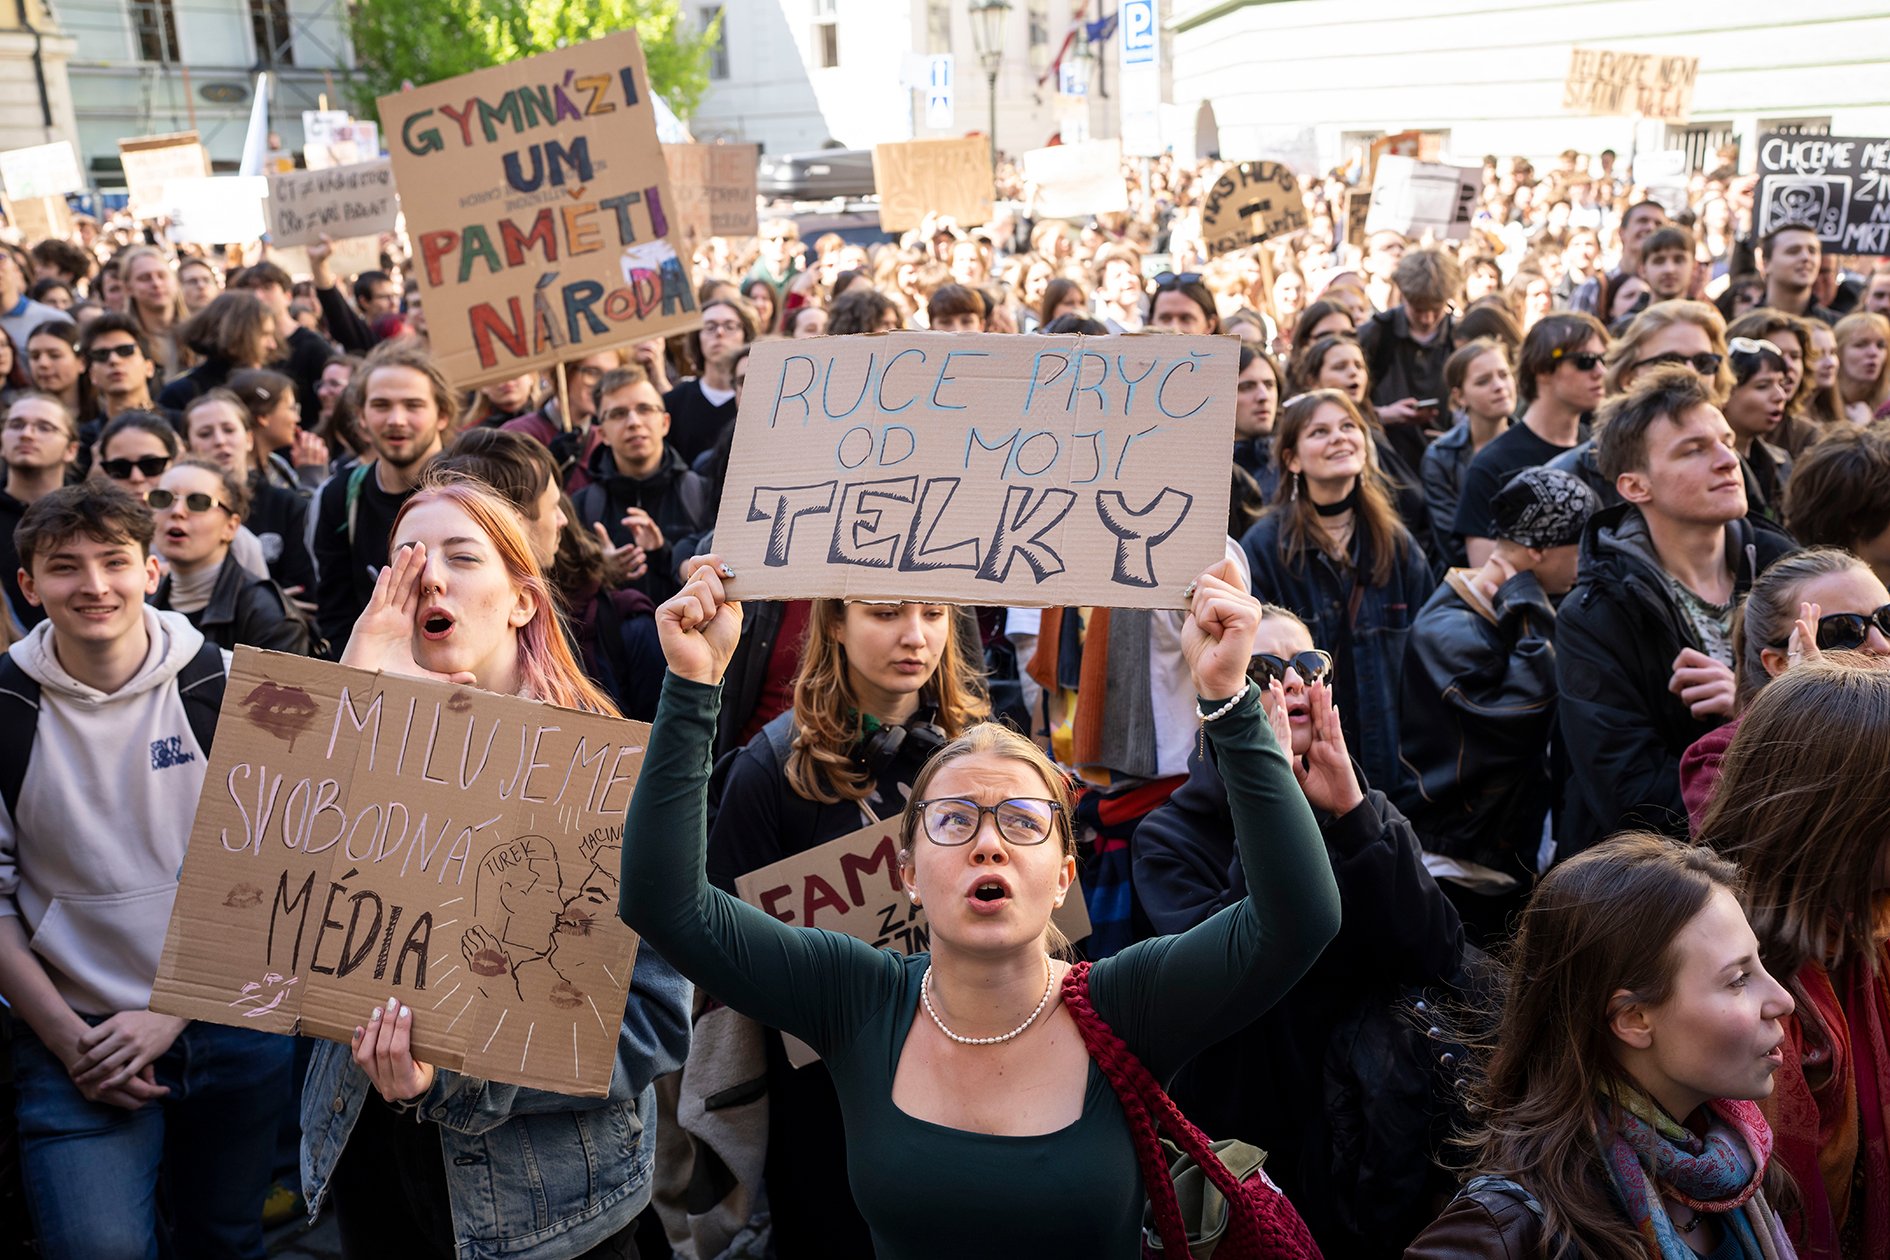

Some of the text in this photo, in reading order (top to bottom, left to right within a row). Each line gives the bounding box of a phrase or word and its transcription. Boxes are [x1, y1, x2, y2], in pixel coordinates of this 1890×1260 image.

[402, 67, 639, 155] GYMNÁZI
[1762, 138, 1856, 170] CHCEME
[503, 136, 594, 192] UM
[1853, 169, 1890, 201] ŽI
[419, 186, 669, 287] PAMĚTI
[468, 256, 695, 369] NÁRODA
[770, 348, 1214, 429] RUCE PRYČ
[837, 424, 1162, 484] OD MOJÍ
[746, 475, 1193, 588] TELKY
[326, 686, 644, 815] MILUJEME
[220, 762, 503, 886] SVOBODNÁ
[484, 840, 537, 877] TUREK
[267, 868, 434, 990] MÉDIA
